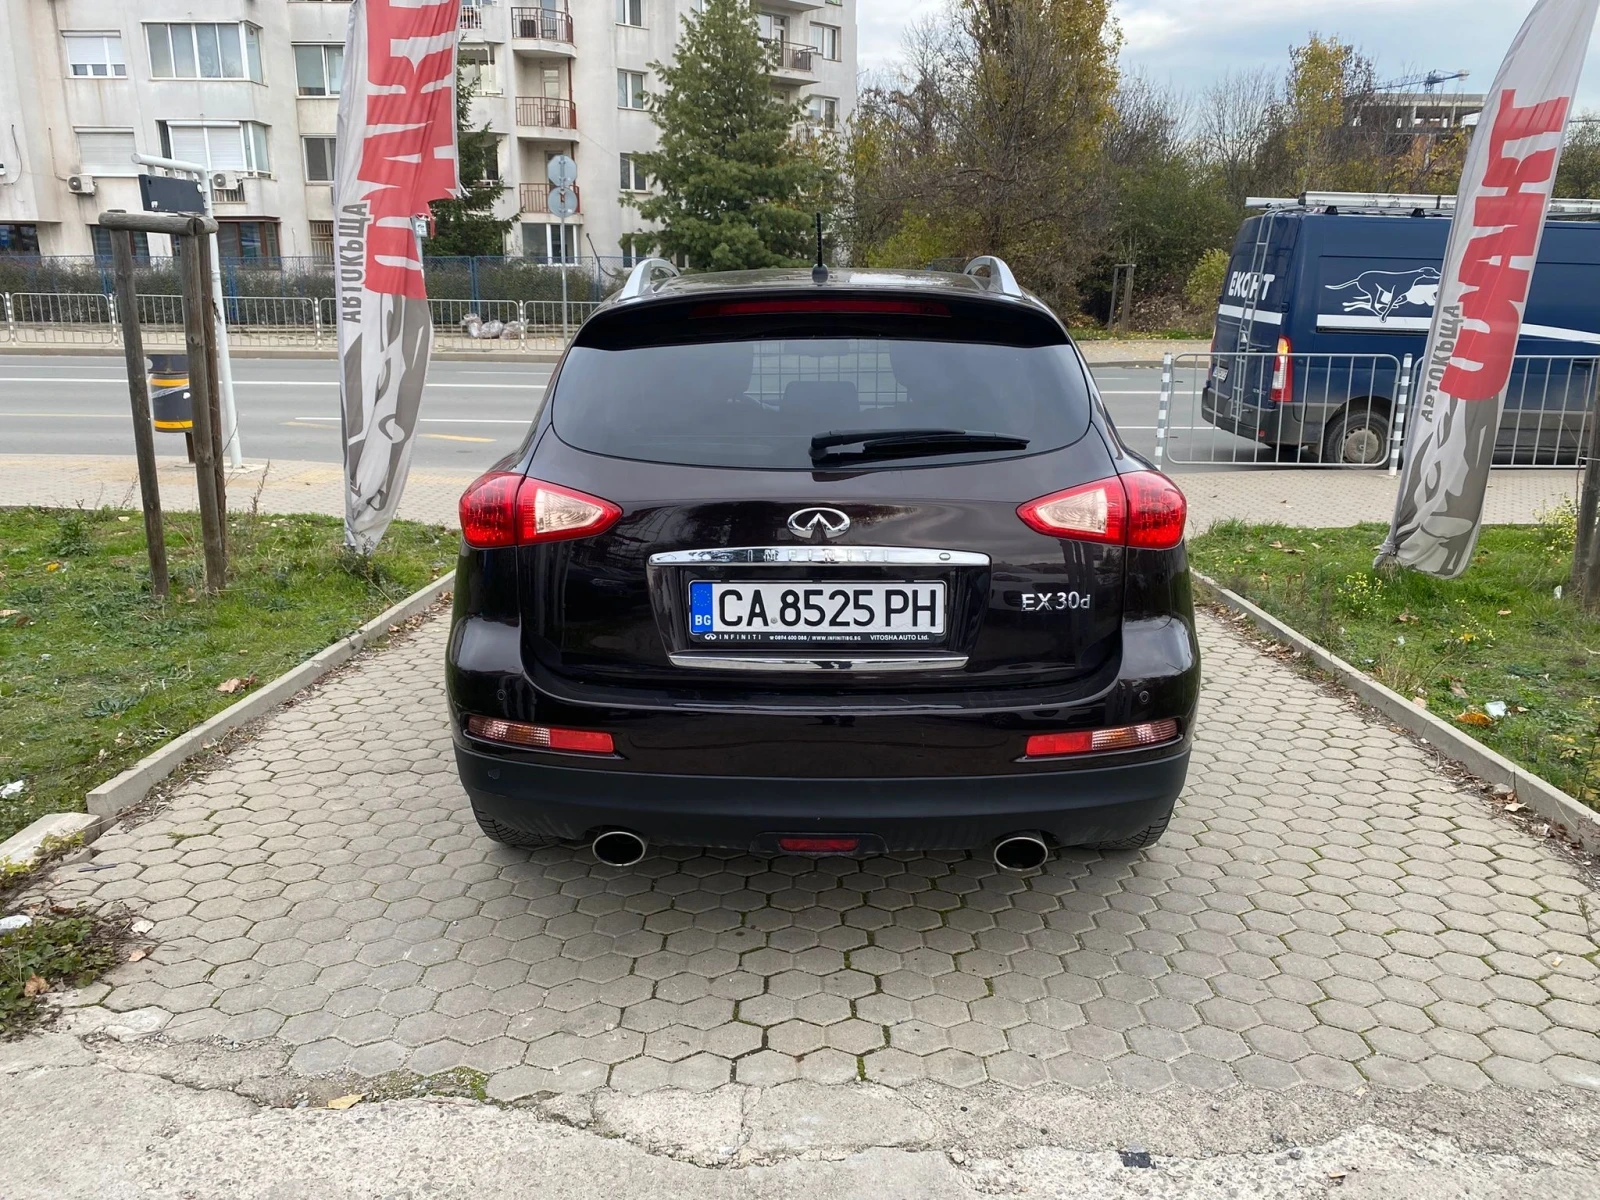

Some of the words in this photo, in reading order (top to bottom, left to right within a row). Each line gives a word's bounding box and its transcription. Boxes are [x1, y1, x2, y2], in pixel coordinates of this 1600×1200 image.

[341, 203, 371, 324] АВТОКЪЩА
[718, 589, 769, 627] CA
[779, 589, 875, 627] 8525
[884, 589, 937, 627] PH
[1021, 593, 1053, 611] EX
[1055, 591, 1091, 609] 30d
[695, 614, 712, 626] BG
